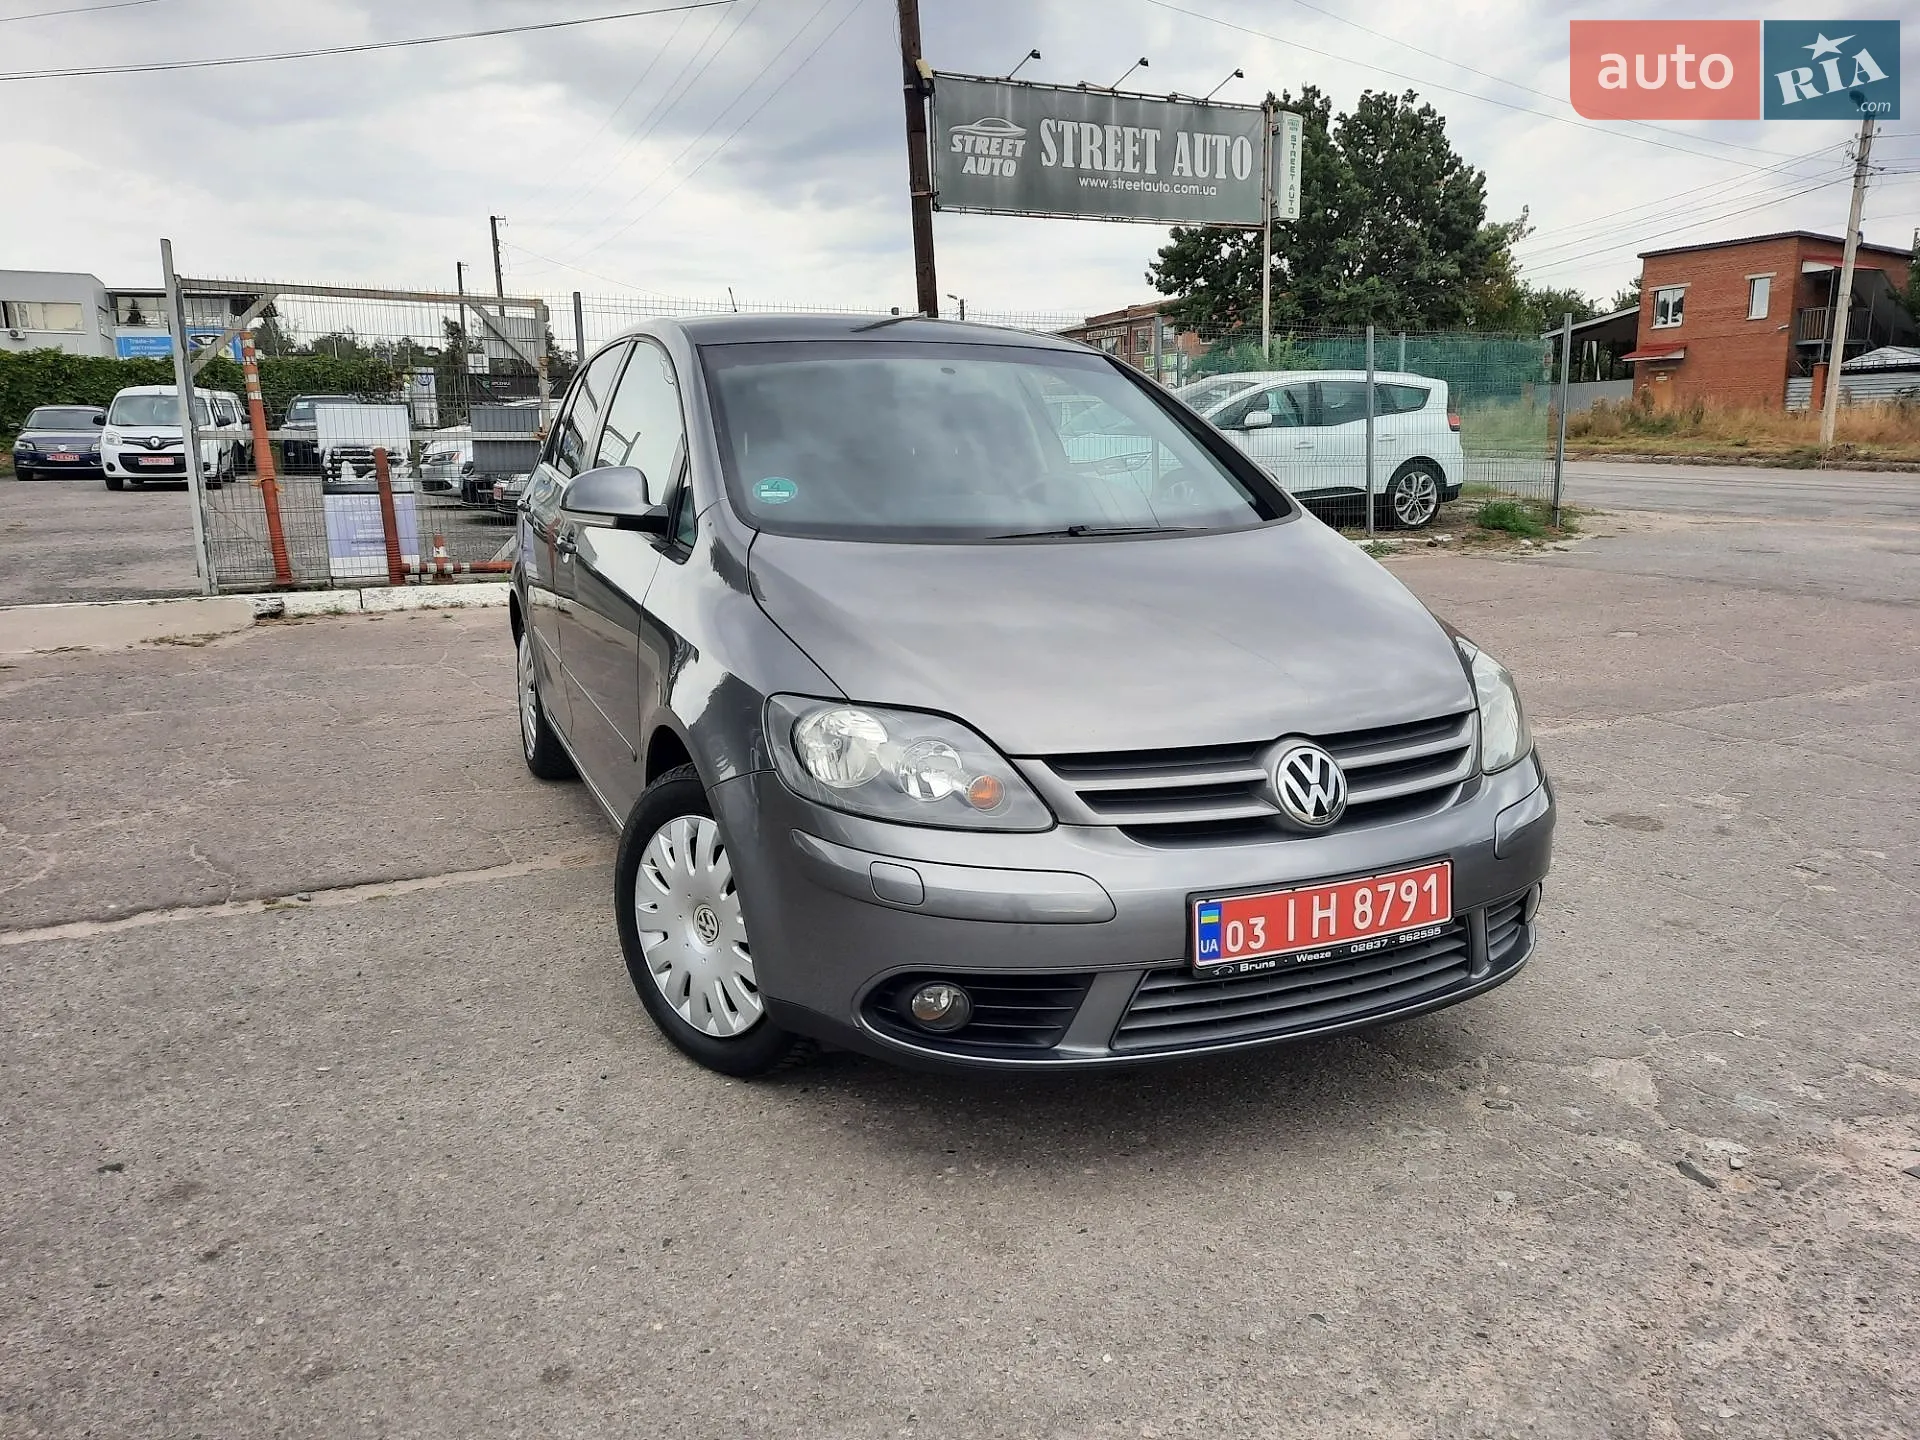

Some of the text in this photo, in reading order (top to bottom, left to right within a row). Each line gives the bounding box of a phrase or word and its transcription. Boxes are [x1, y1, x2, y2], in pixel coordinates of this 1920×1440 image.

[951, 134, 1026, 158] STREET
[1040, 118, 1252, 181] STREET AUTO
[1289, 134, 1297, 180] STREET
[962, 156, 1017, 178] AUTO
[1079, 176, 1217, 196] www.streetauto.com.ua
[1288, 184, 1296, 214] AUTO
[1226, 873, 1438, 953] 03 IH 8791
[1200, 938, 1219, 954] UA
[1240, 959, 1276, 972] Bruns
[1350, 938, 1388, 953] 02837
[1399, 926, 1442, 944] 962595
